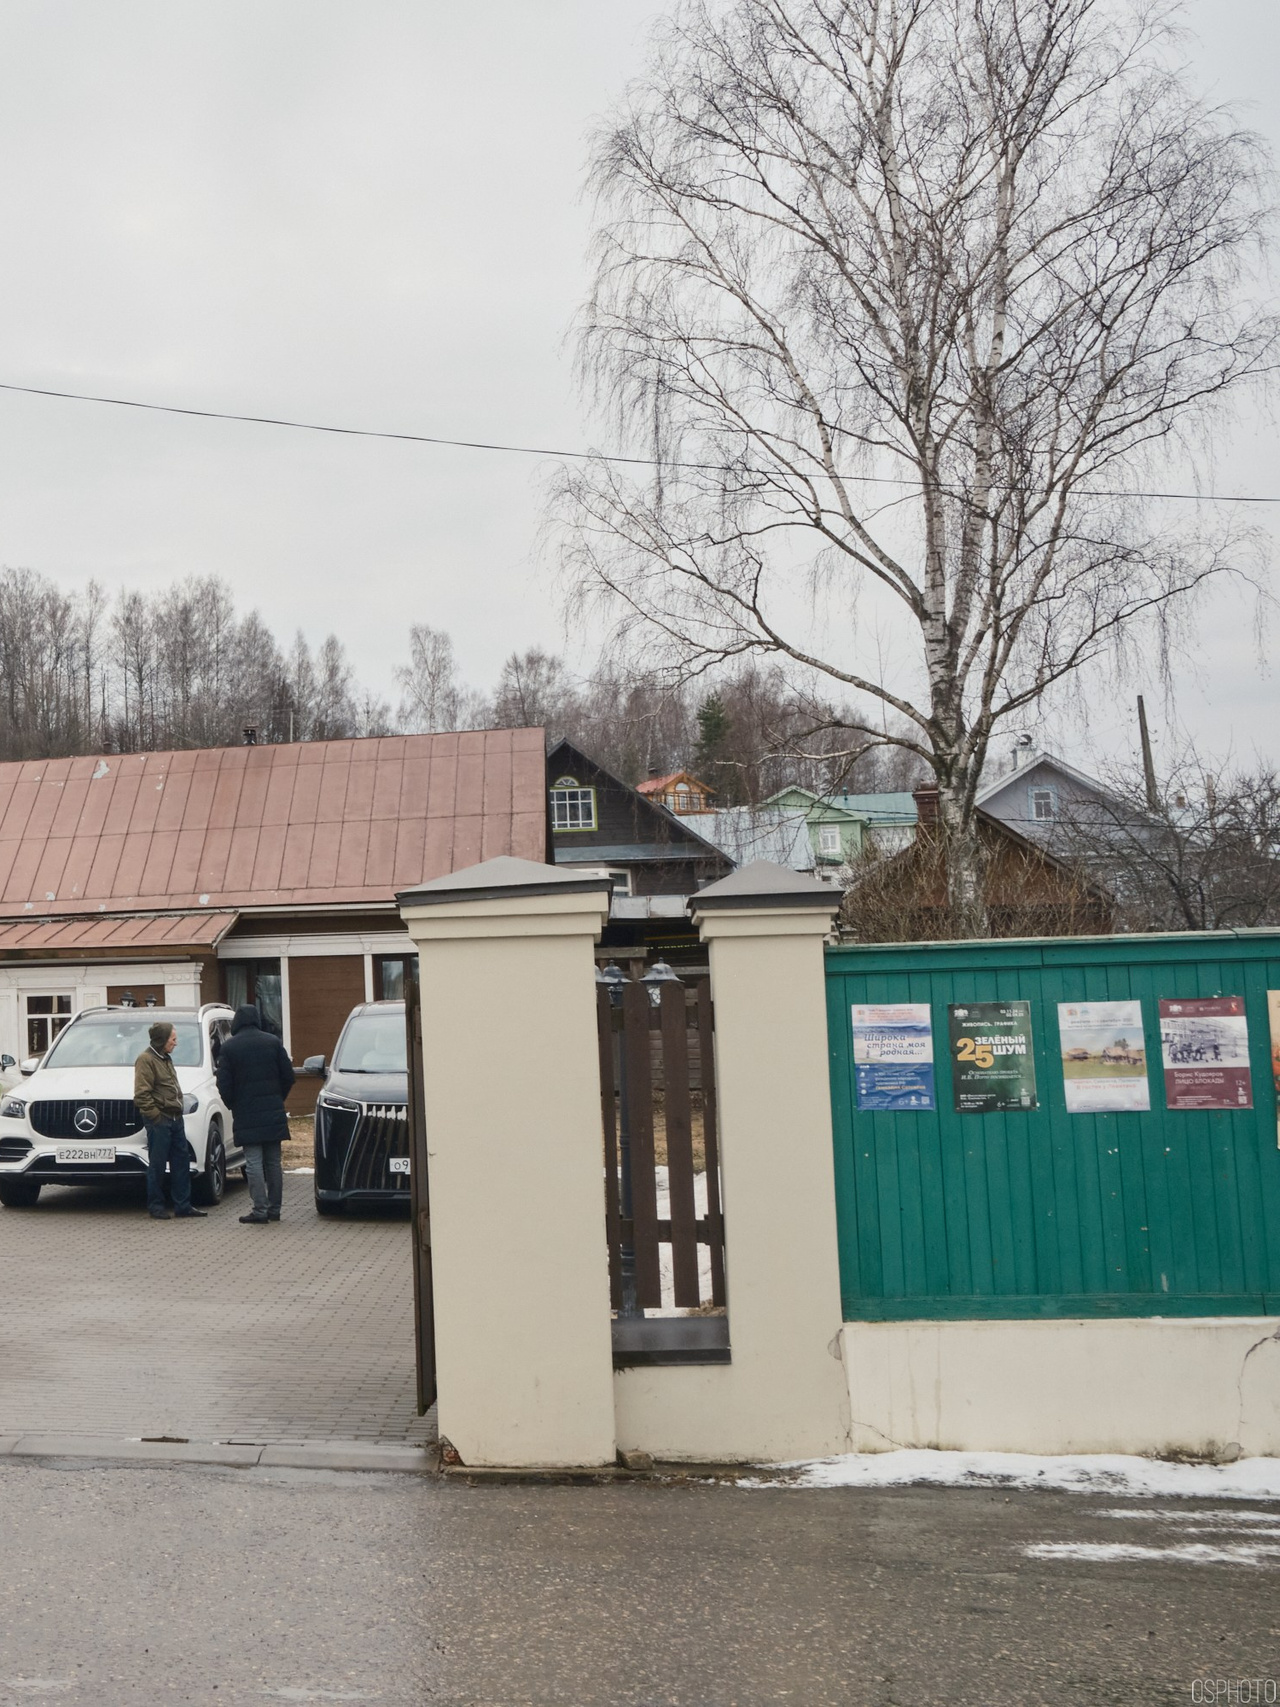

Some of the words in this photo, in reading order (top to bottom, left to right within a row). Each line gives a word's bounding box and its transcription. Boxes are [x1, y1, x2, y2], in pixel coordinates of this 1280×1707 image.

[864, 1033, 906, 1043] Широка
[975, 1034, 1026, 1045] ЗЕЛЁНЫЙ
[867, 1042, 904, 1050] страна
[992, 1045, 1026, 1055] ШУМ
[956, 1037, 995, 1069] 25
[59, 1149, 96, 1160] Е222ВН
[97, 1148, 112, 1157] 777
